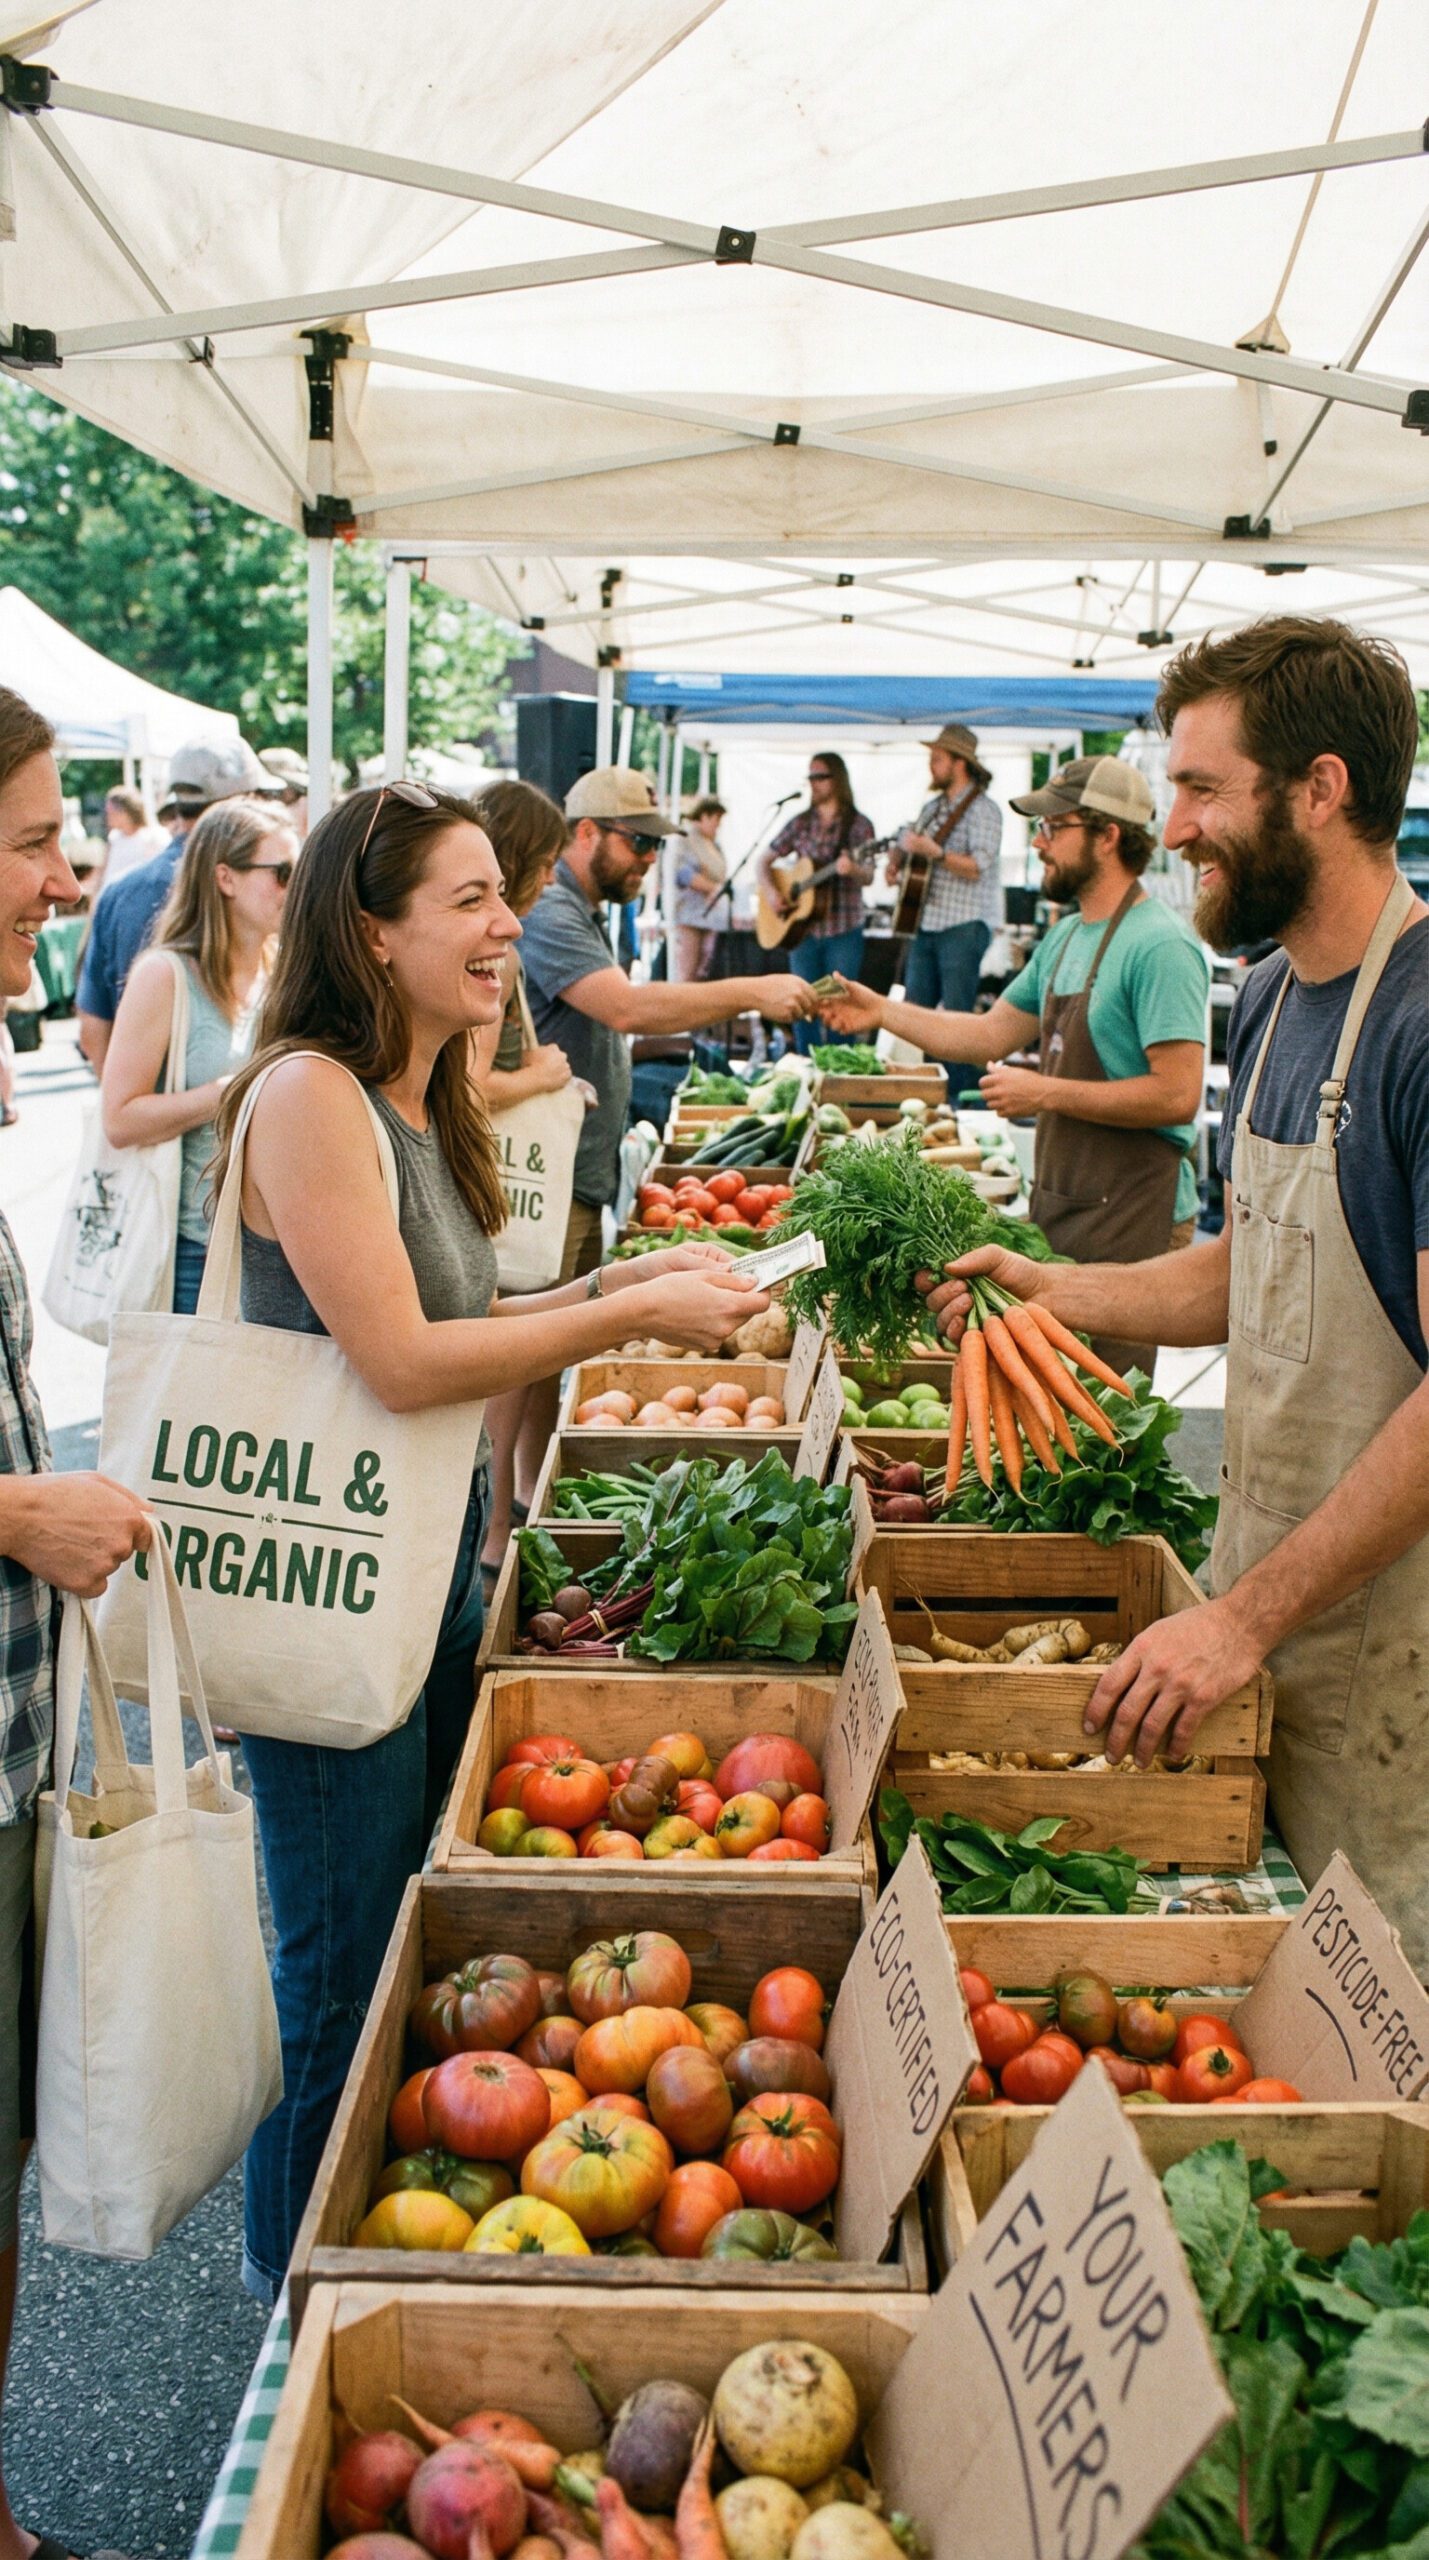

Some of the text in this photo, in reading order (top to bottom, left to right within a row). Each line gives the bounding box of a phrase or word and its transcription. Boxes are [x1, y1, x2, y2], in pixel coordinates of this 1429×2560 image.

[526, 1142, 546, 1174] &
[151, 1419, 389, 1517] LOCAL &
[869, 1891, 940, 2136] ECO-CERTIFIED
[1302, 1887, 1424, 2096] PESTICIDE-FREE
[984, 2190, 1123, 2560] FARMERS
[1064, 2155, 1171, 2403] YOUR
